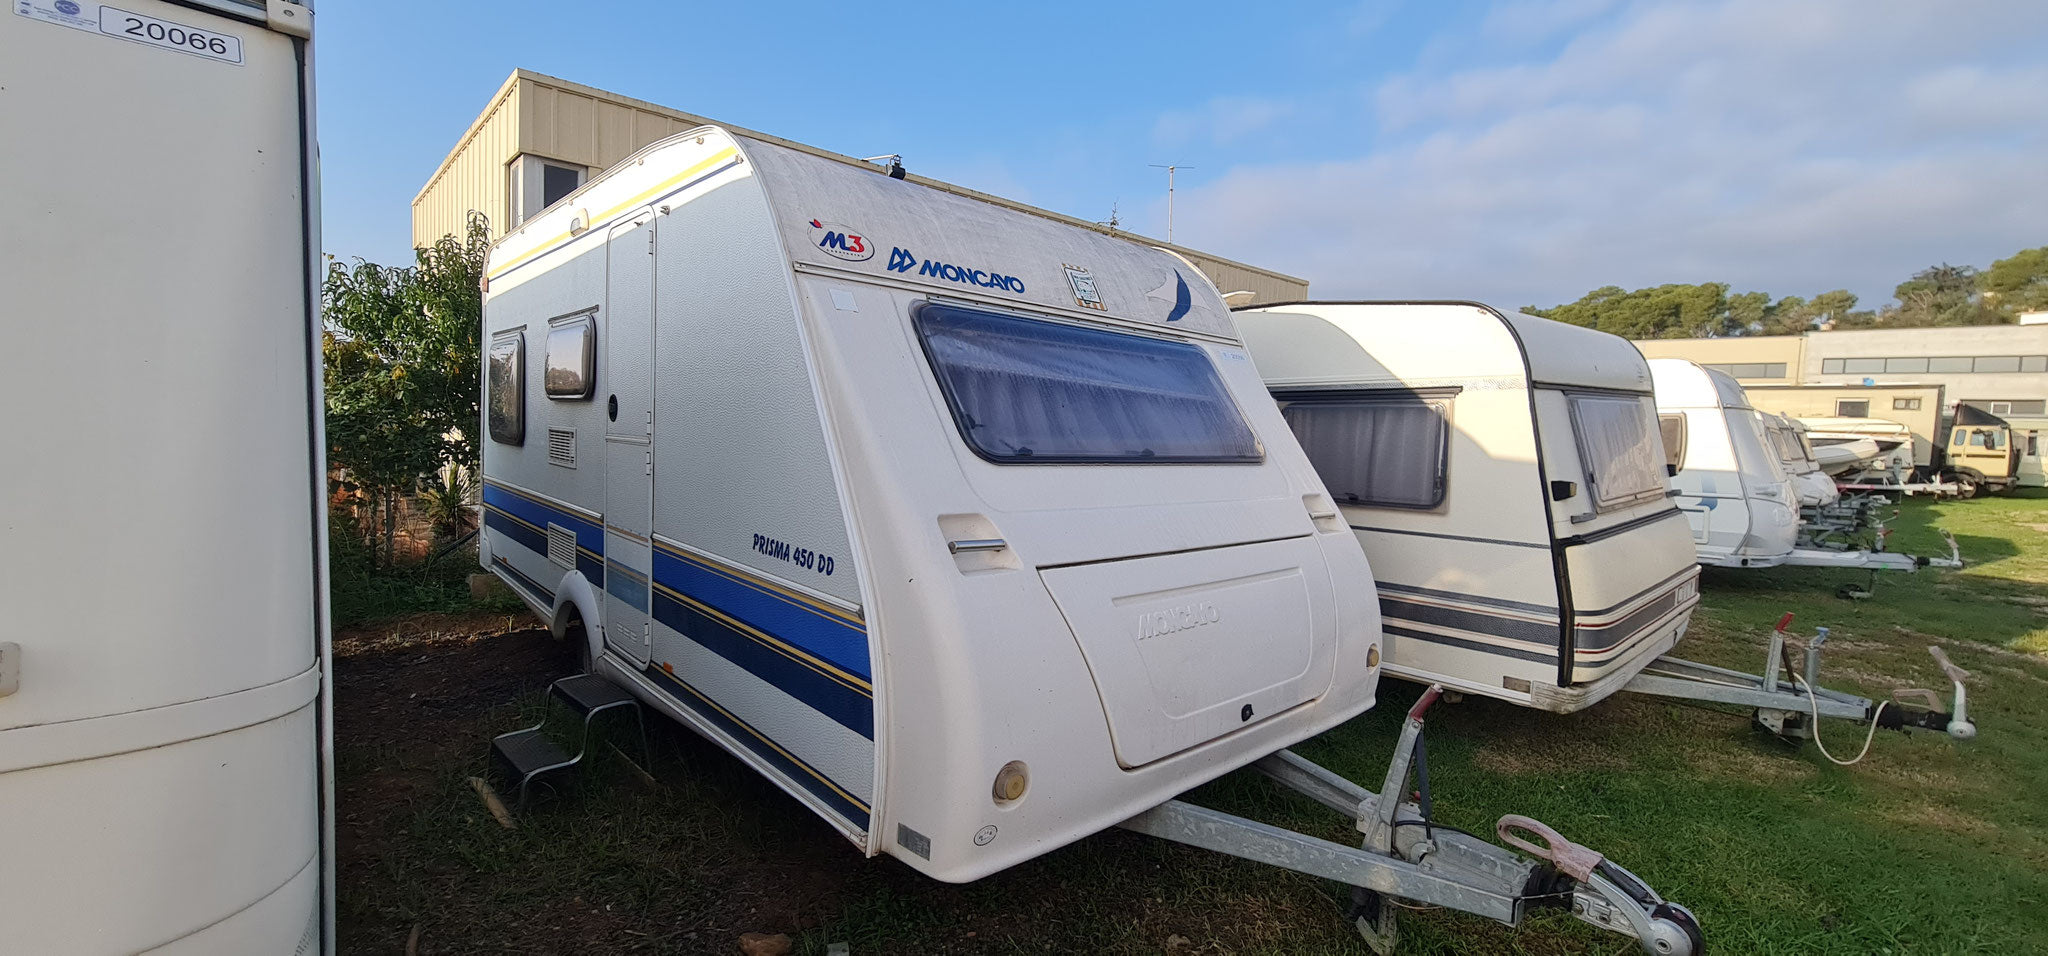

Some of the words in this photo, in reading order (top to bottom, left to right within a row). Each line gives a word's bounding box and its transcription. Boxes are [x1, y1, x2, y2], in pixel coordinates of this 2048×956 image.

[125, 17, 228, 55] 20066
[819, 230, 865, 253] M3
[919, 259, 1026, 294] MONCAYO
[752, 533, 790, 562] PRISMA
[793, 547, 814, 570] 450
[818, 553, 835, 576] DD
[1137, 602, 1220, 641] MONCAYO
